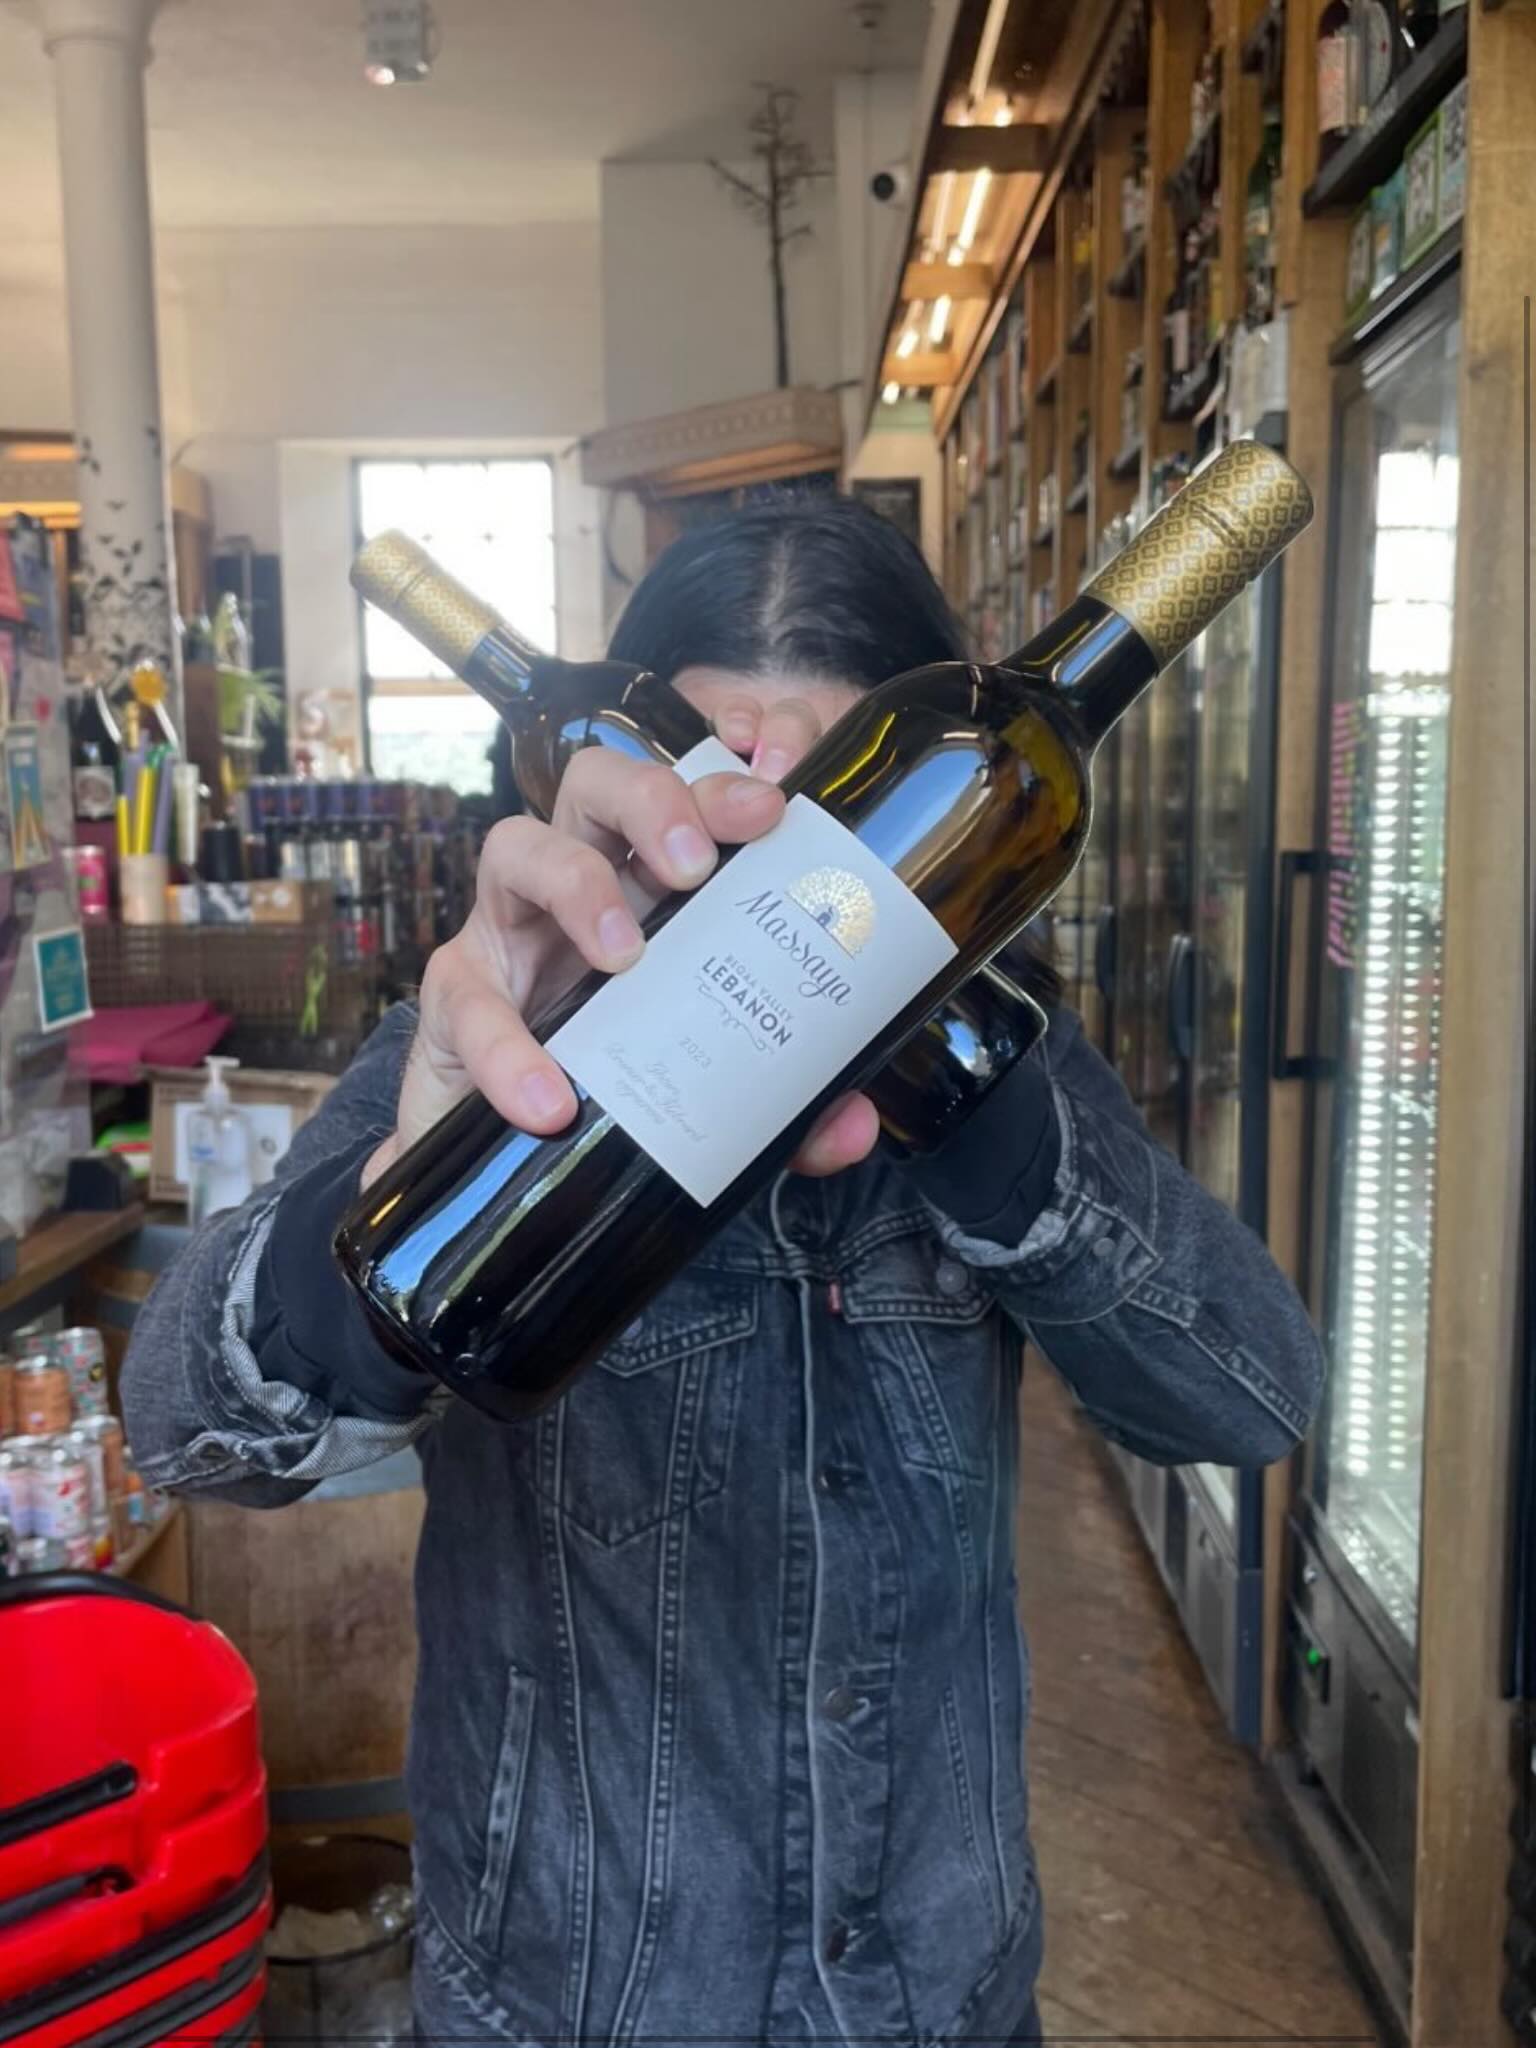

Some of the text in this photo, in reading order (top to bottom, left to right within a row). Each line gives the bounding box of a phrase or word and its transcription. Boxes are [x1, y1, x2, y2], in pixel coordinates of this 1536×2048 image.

[734, 889, 852, 1007] Massaya
[701, 956, 793, 1048] LEBANON
[759, 986, 795, 1023] VALLEY
[678, 1036, 712, 1069] 2023
